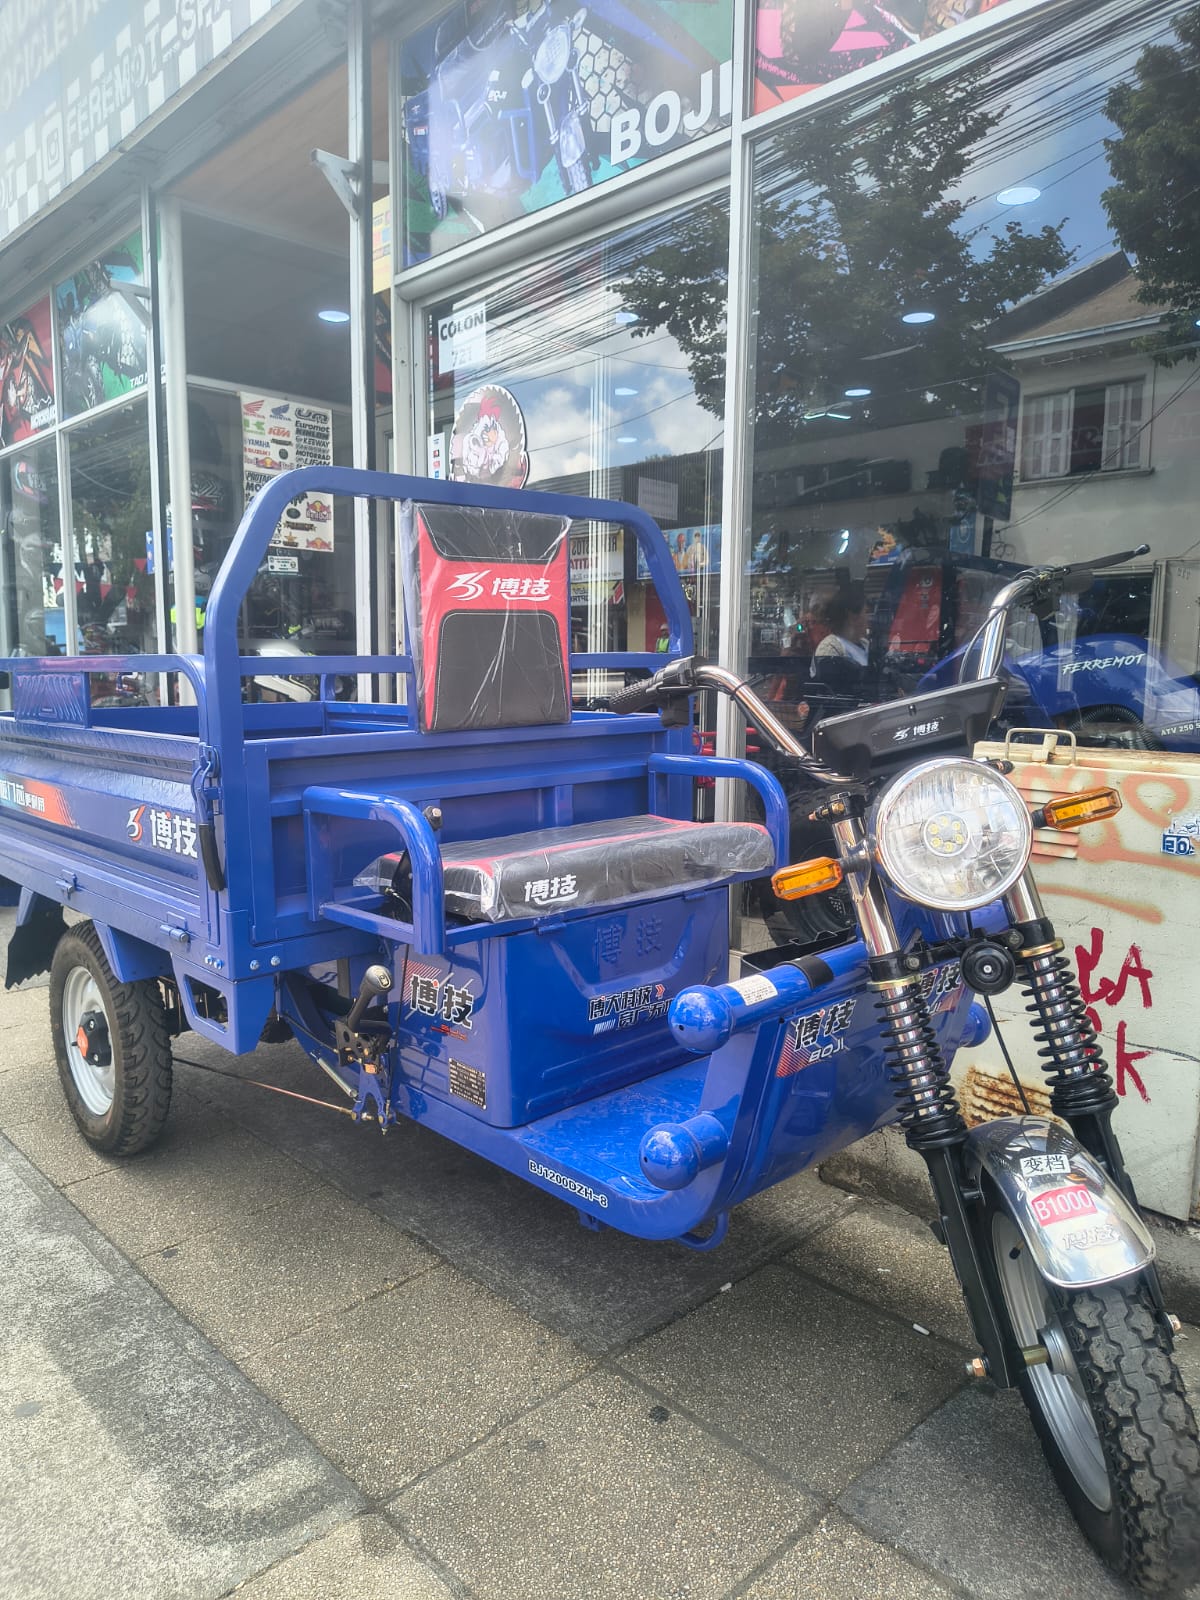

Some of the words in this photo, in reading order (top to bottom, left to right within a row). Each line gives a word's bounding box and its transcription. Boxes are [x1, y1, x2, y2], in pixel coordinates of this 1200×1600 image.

[610, 61, 732, 167] BOJI
[295, 420, 330, 433] Euromot
[248, 438, 271, 449] YAMAHA
[303, 437, 330, 448] KEEWAY
[296, 450, 331, 461] MOTORRAD
[491, 577, 552, 601] 博技
[1062, 653, 1147, 676] FERREMOT
[913, 720, 940, 736] 博技
[1160, 727, 1177, 737] ATV
[1178, 723, 1194, 733] 250
[150, 808, 198, 858] 博技
[524, 873, 580, 905] 博技
[410, 973, 475, 1029] 博技
[793, 998, 857, 1053] 博技
[808, 1036, 844, 1063] BOJI
[1023, 1154, 1066, 1173] 变档
[528, 1159, 609, 1208] BJ1200DZH-8
[1034, 1189, 1092, 1221] B1000
